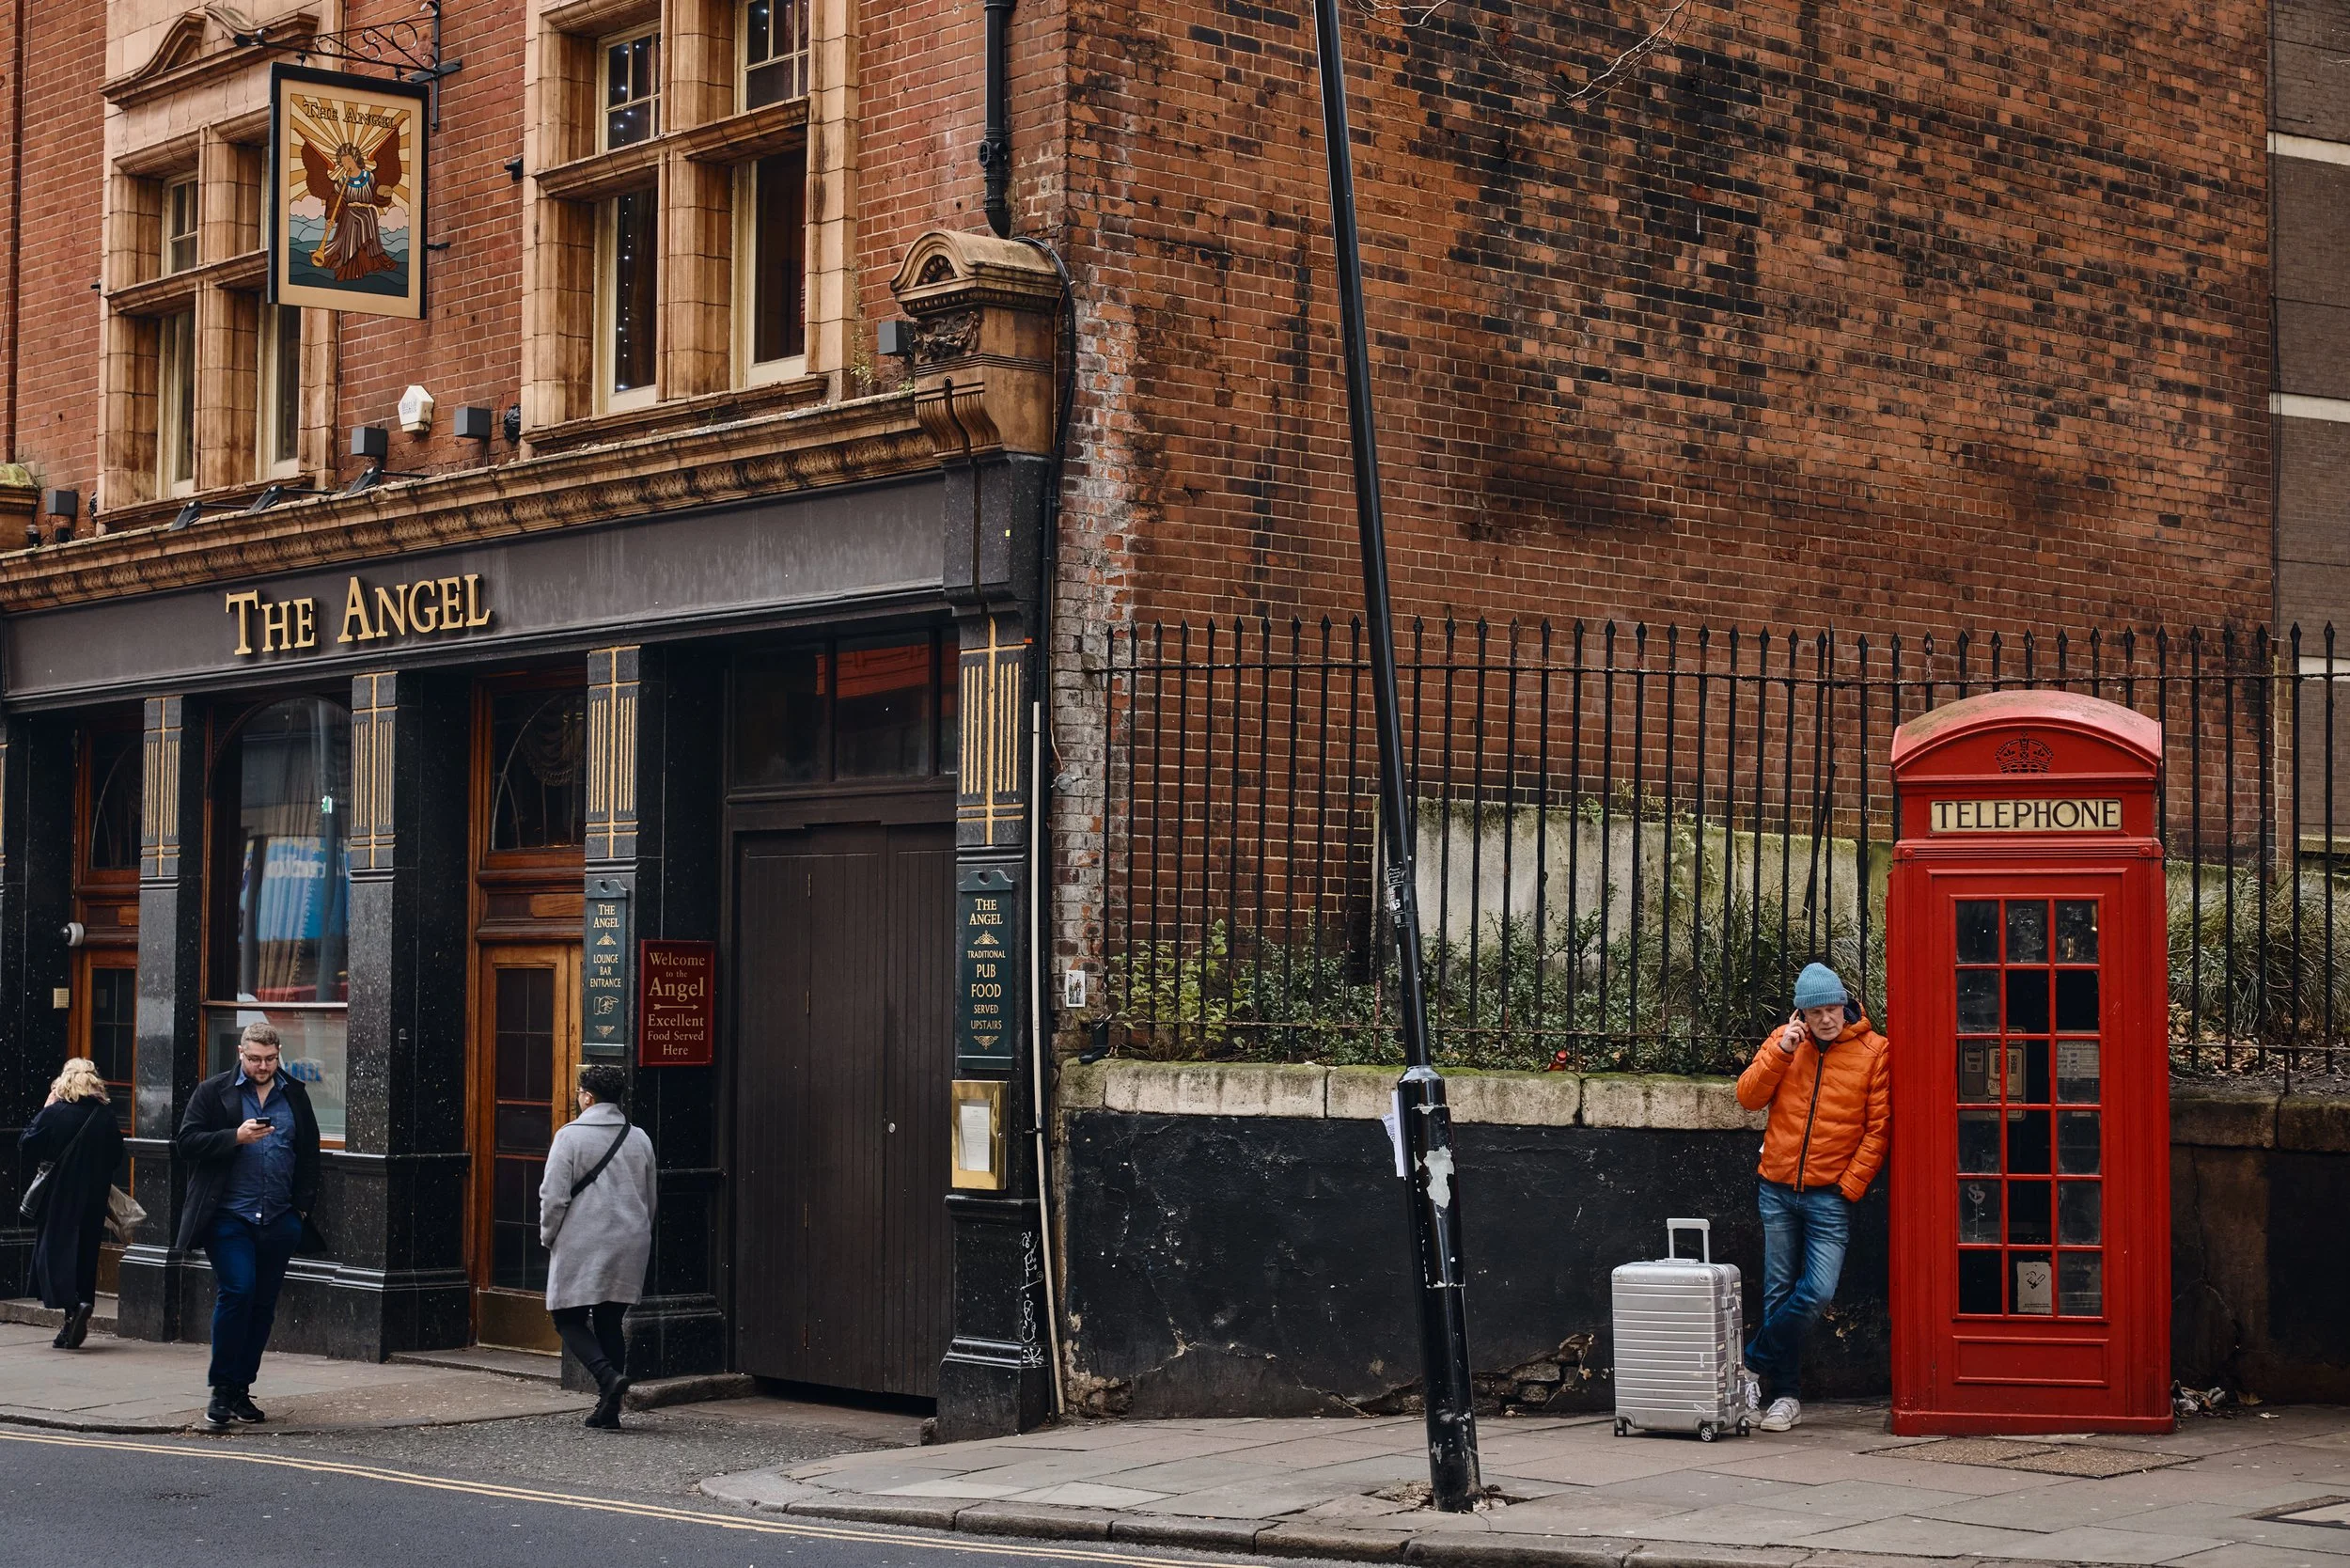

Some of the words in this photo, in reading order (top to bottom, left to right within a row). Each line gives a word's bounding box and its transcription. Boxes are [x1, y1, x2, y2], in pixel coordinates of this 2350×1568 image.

[303, 100, 338, 120] THE
[343, 107, 397, 128] ANGEL
[226, 588, 317, 655] THE
[337, 573, 491, 644] ANGEL
[1935, 800, 2120, 829] TELEPHONE
[598, 903, 616, 916] THE
[975, 898, 996, 911] THE
[593, 917, 620, 929] ANGEL
[969, 913, 1003, 926] ANGEL
[593, 953, 619, 964] LOUNGE
[650, 951, 706, 966] Welcome
[967, 949, 1006, 959] TRADITIONAL
[600, 965, 612, 976] BAR
[676, 969, 688, 978] the
[976, 964, 996, 979] PUB
[589, 978, 621, 988] ENTRANCE
[648, 977, 705, 1003] Angel
[971, 983, 1002, 998] FOOD
[973, 1004, 999, 1014] SERVED
[648, 1013, 705, 1027] Excellent
[970, 1019, 1002, 1030] UPSTAIRS
[648, 1029, 670, 1041] Food
[674, 1030, 704, 1041] Served
[663, 1043, 689, 1056] Here
